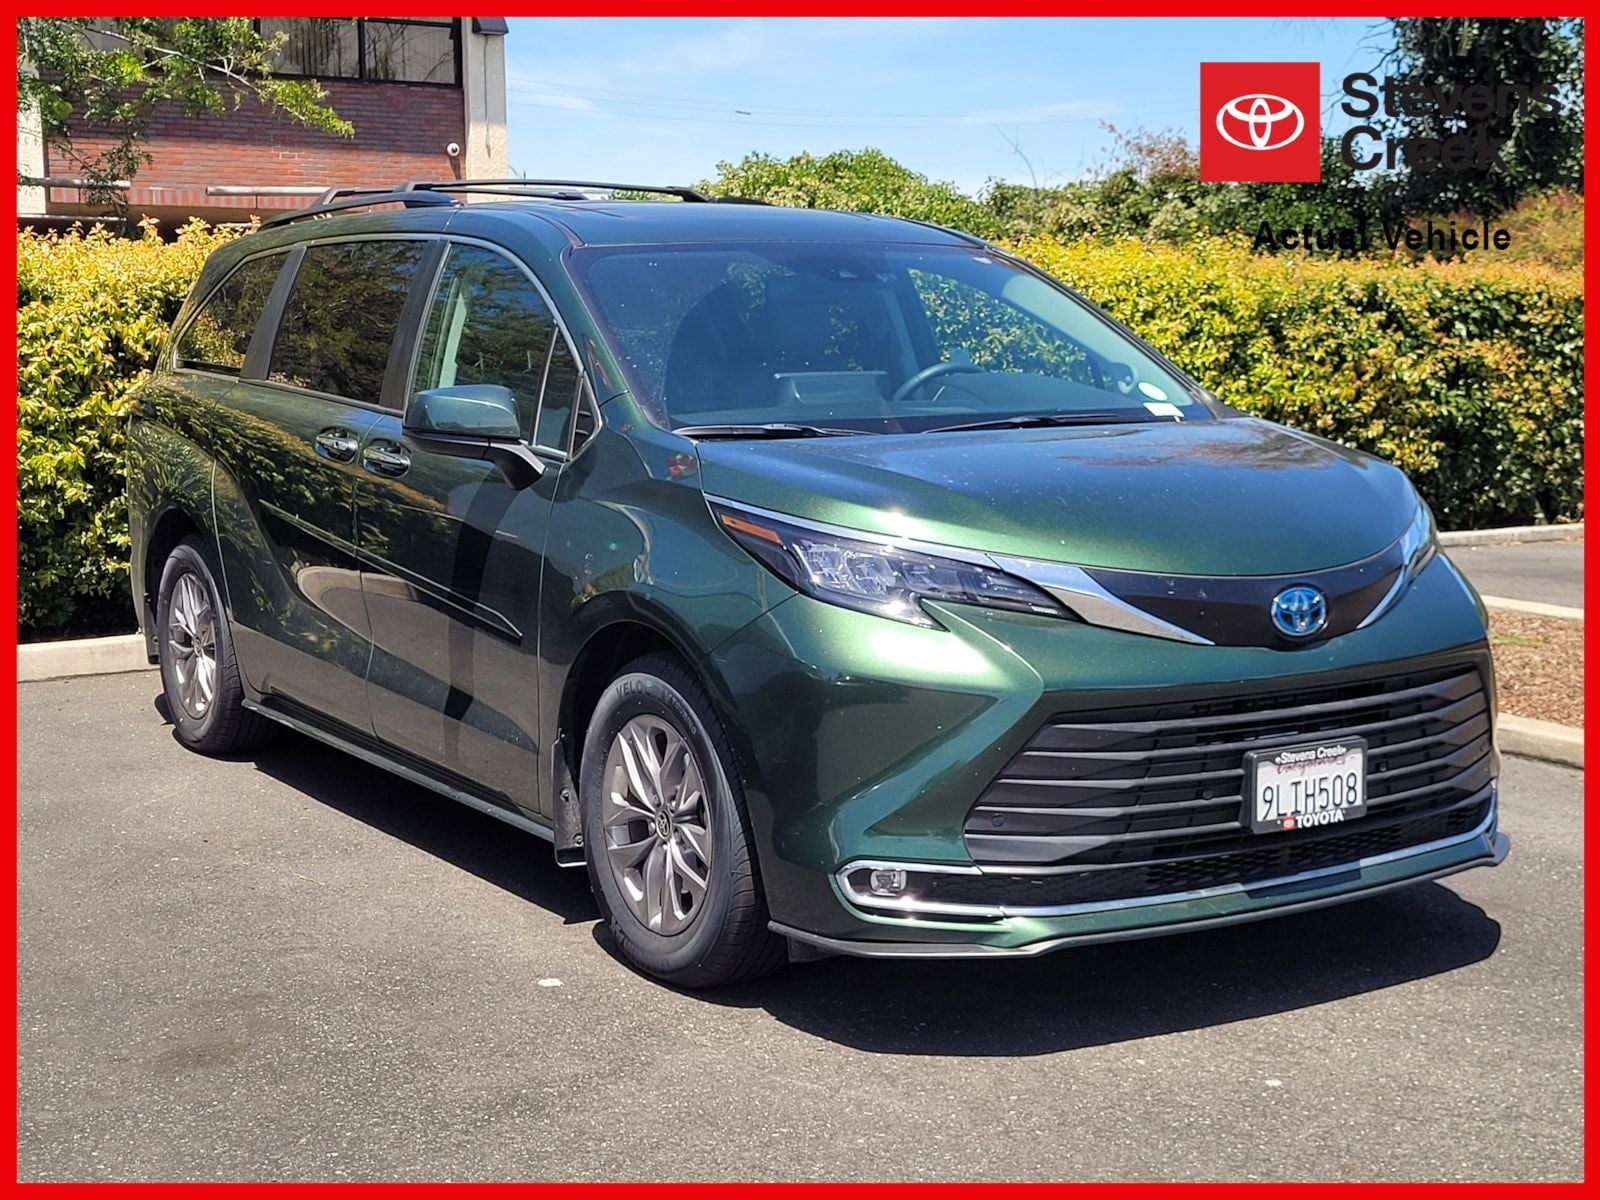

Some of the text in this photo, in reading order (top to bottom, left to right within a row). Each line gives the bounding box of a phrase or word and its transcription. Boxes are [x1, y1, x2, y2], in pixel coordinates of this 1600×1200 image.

[1280, 745, 1342, 764] Stevens Creek
[1262, 772, 1358, 820] 9LIH508
[1296, 809, 1345, 828] TOYOTA
